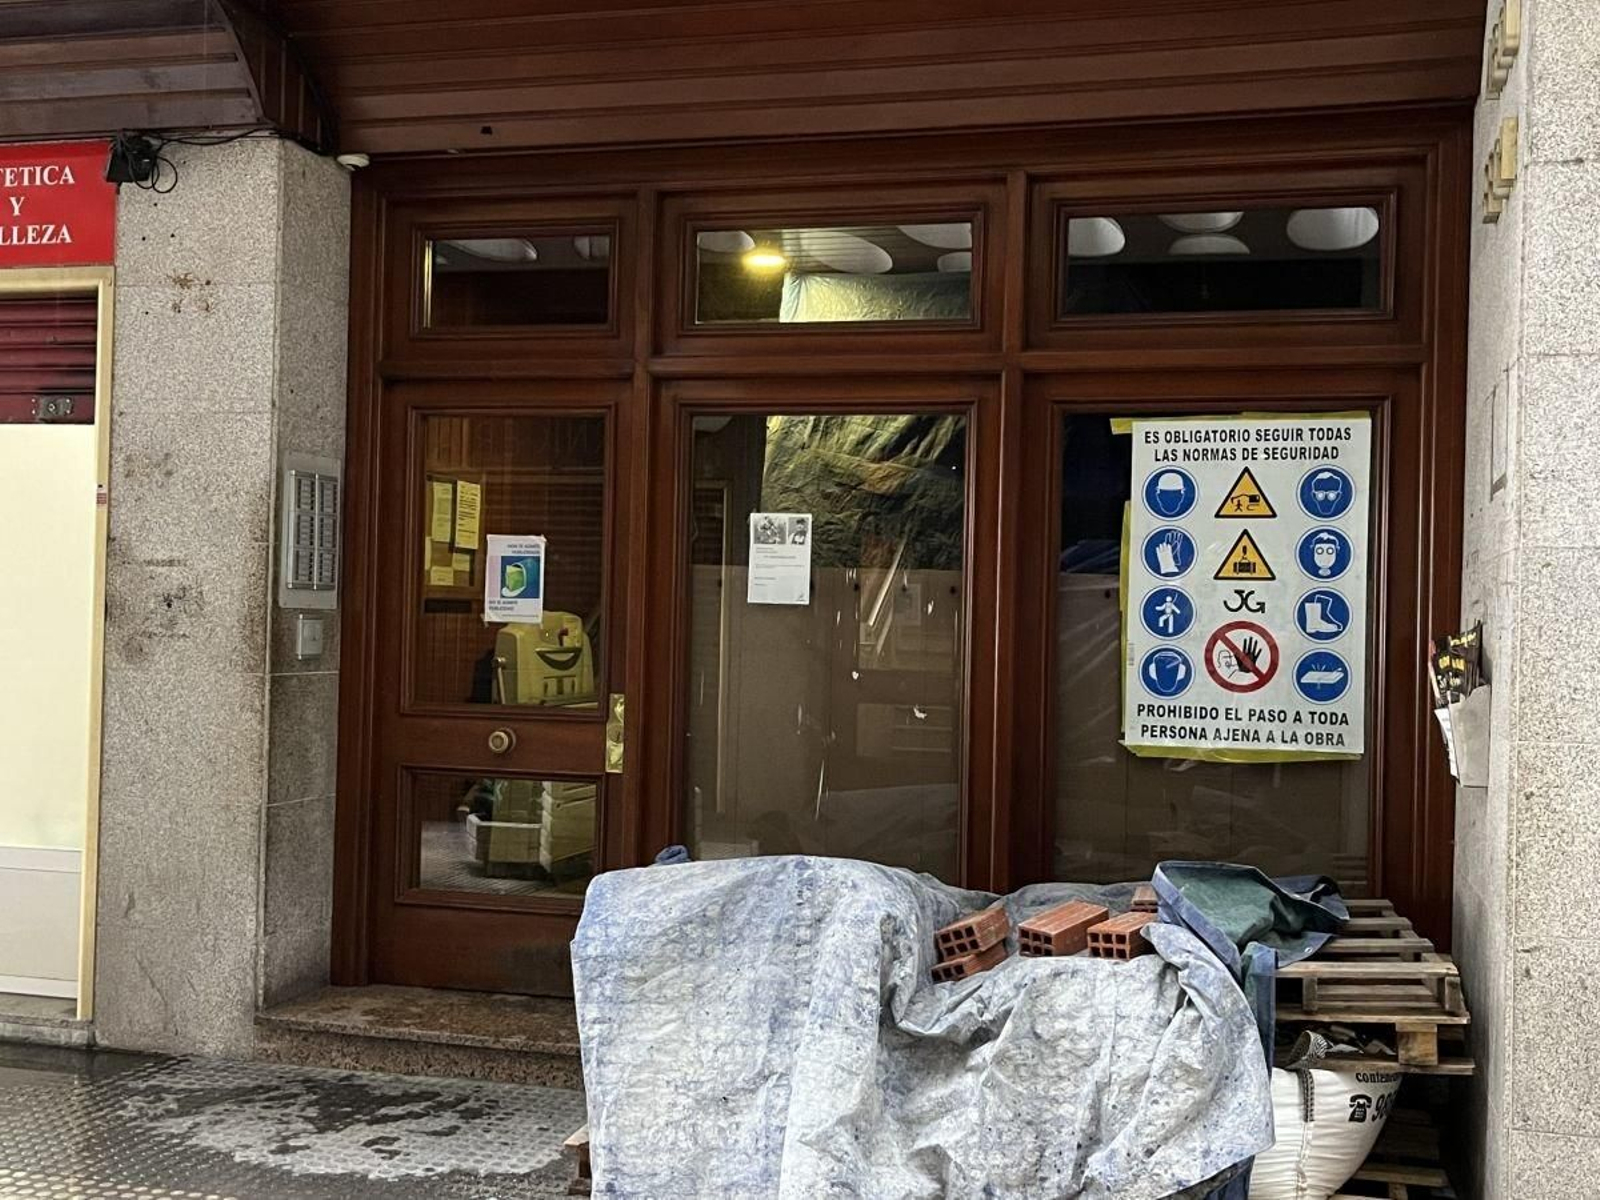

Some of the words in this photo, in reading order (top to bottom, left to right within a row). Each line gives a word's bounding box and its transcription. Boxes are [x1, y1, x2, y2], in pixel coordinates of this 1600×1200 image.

[9, 196, 25, 217] Y
[1144, 430, 1160, 444] ES
[1164, 428, 1251, 444] OBLIGATORIO
[1255, 427, 1304, 442] SEGUIR
[1308, 427, 1352, 441] TODAS
[1154, 448, 1178, 462] LAS
[1183, 447, 1238, 462] NORMAS
[1242, 447, 1258, 461] DE
[1263, 446, 1340, 461] SEGURIDAD
[1137, 703, 1219, 720] PROHIBIDO
[1225, 707, 1243, 721] EL
[1248, 708, 1288, 723] PASO
[1292, 710, 1303, 724] A
[1308, 711, 1349, 726] TODA
[1141, 724, 1208, 741] PERSONA
[1213, 728, 1261, 743] AJENA
[1266, 730, 1276, 744] A
[1281, 730, 1299, 744] LA
[1304, 732, 1346, 747] OBRA
